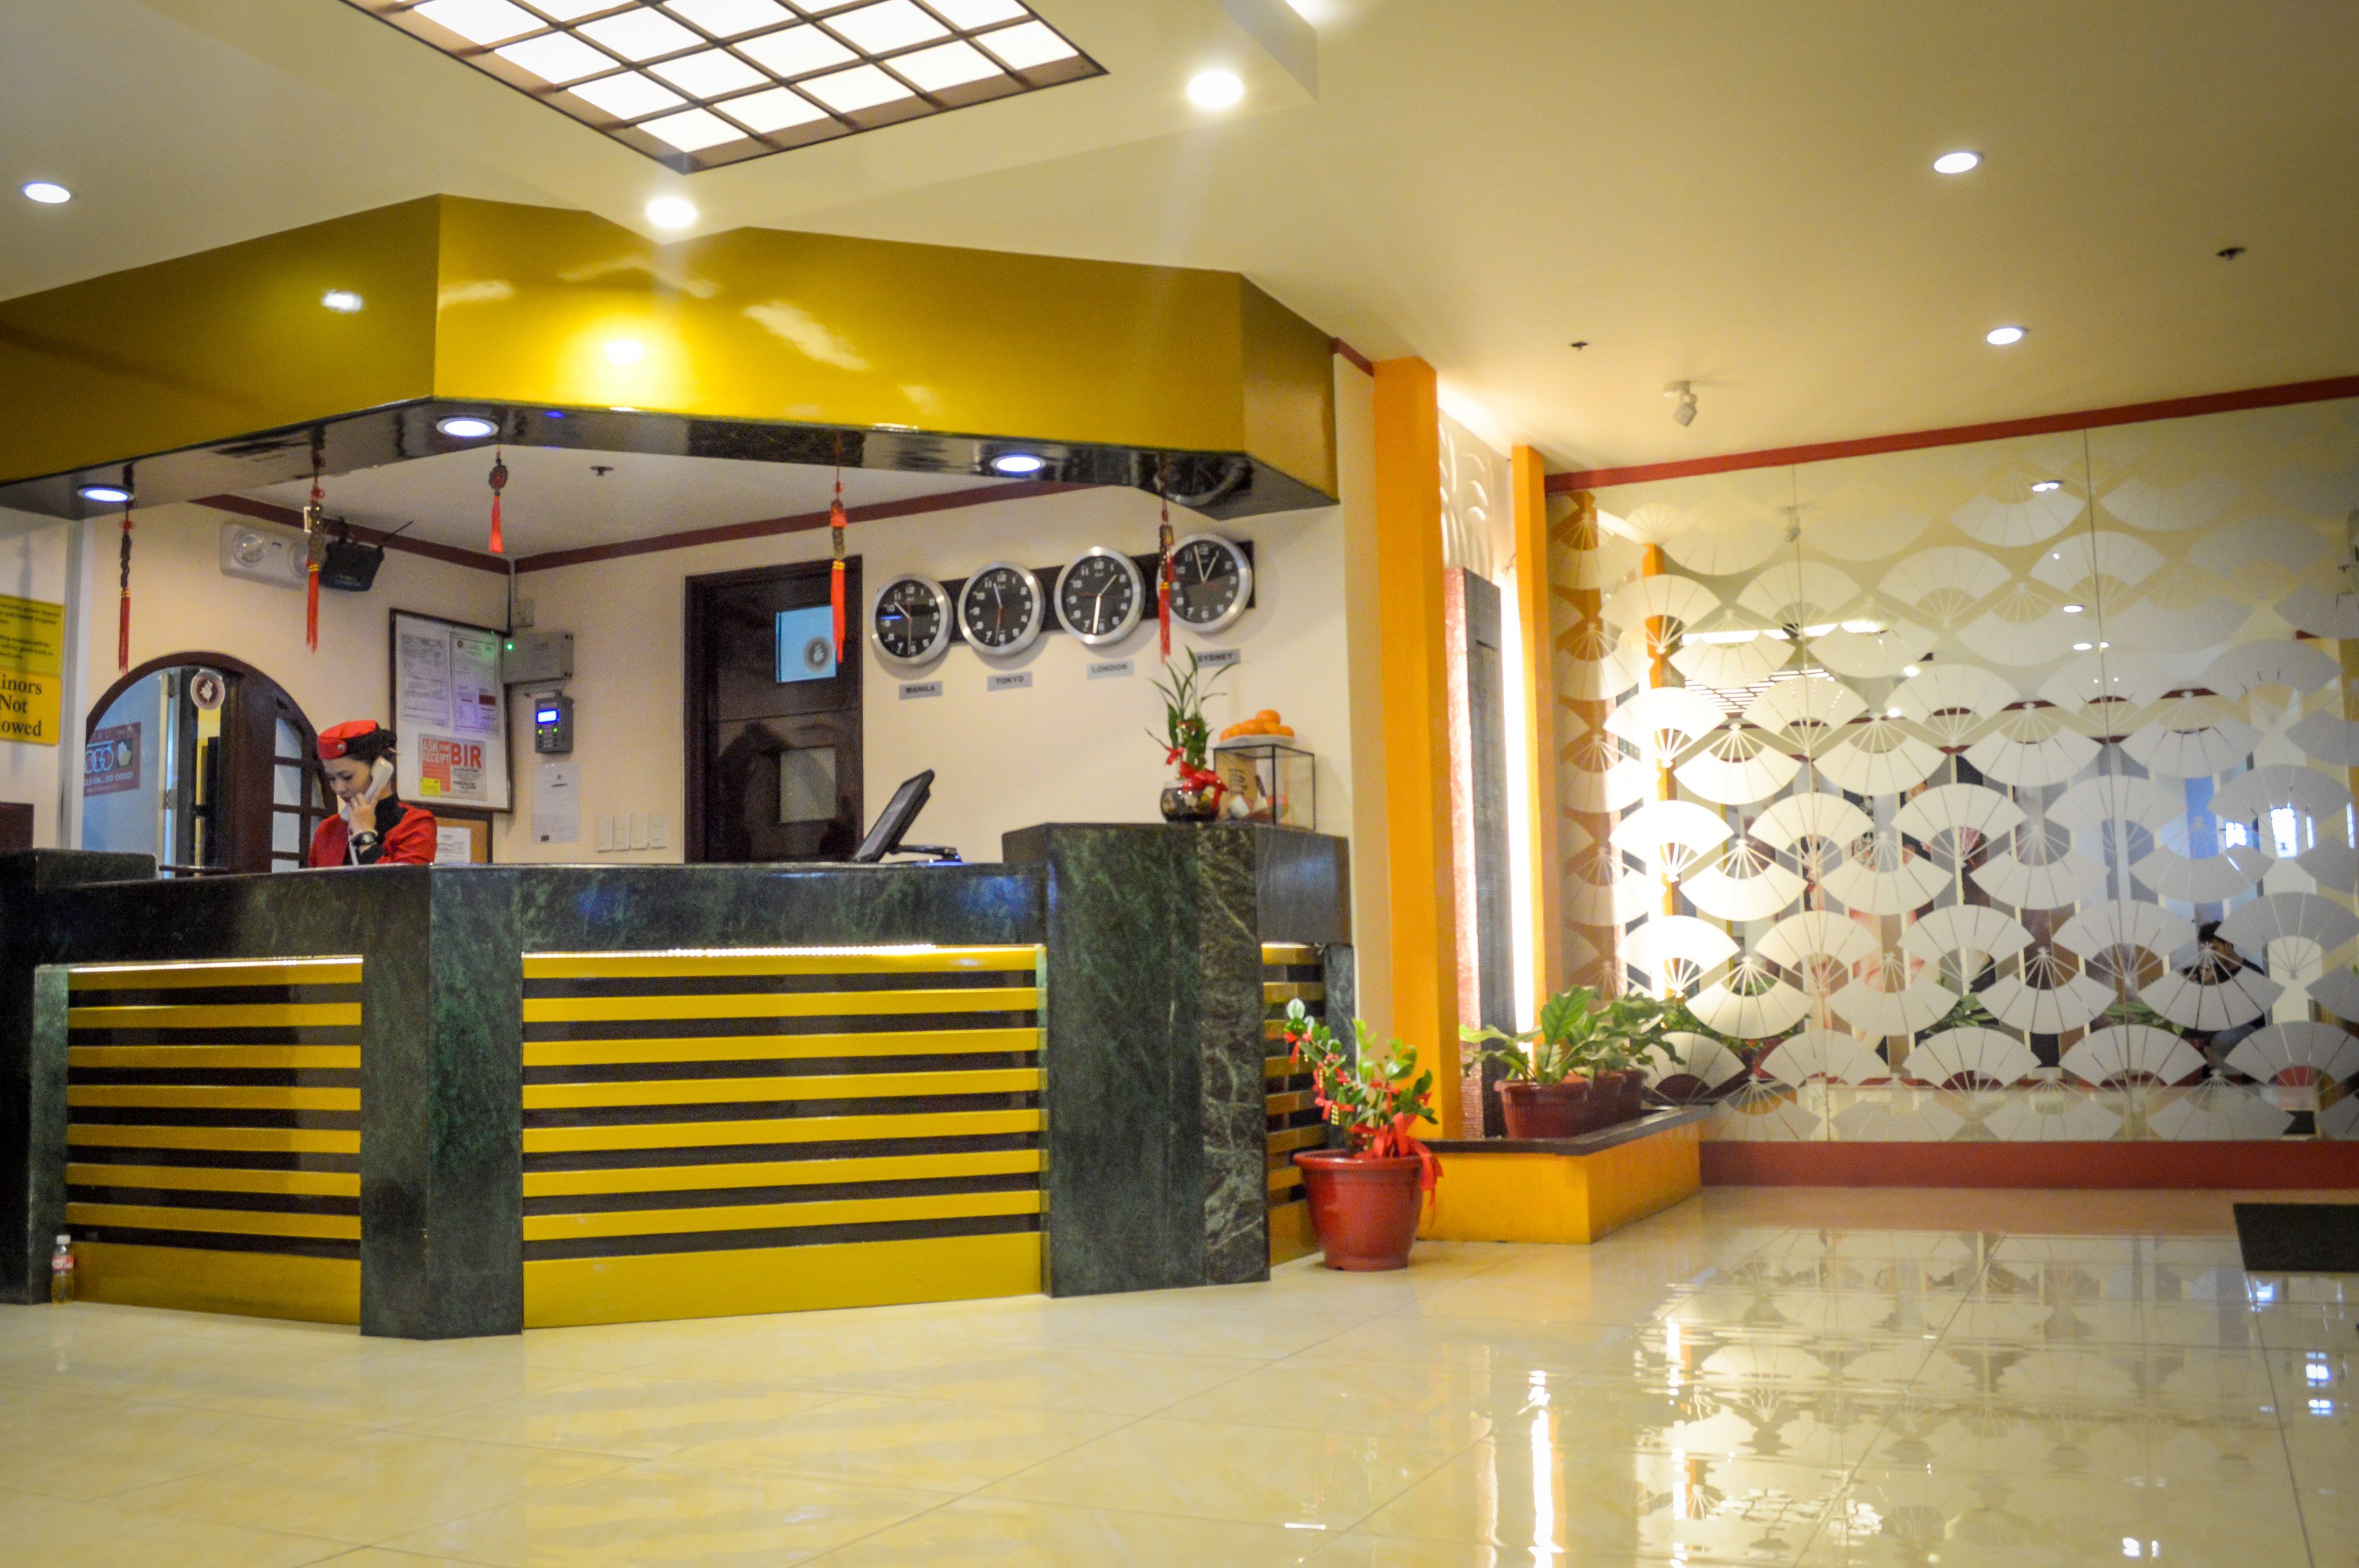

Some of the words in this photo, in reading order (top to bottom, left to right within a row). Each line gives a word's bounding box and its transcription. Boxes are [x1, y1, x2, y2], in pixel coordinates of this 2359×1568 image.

[1197, 652, 1234, 663] SYDNEY
[1092, 664, 1127, 674] LONDON
[0, 674, 42, 695] inors
[996, 676, 1023, 685] TOKYO
[906, 684, 936, 693] MANILA
[0, 694, 28, 714] Not
[452, 743, 482, 768] BIR
